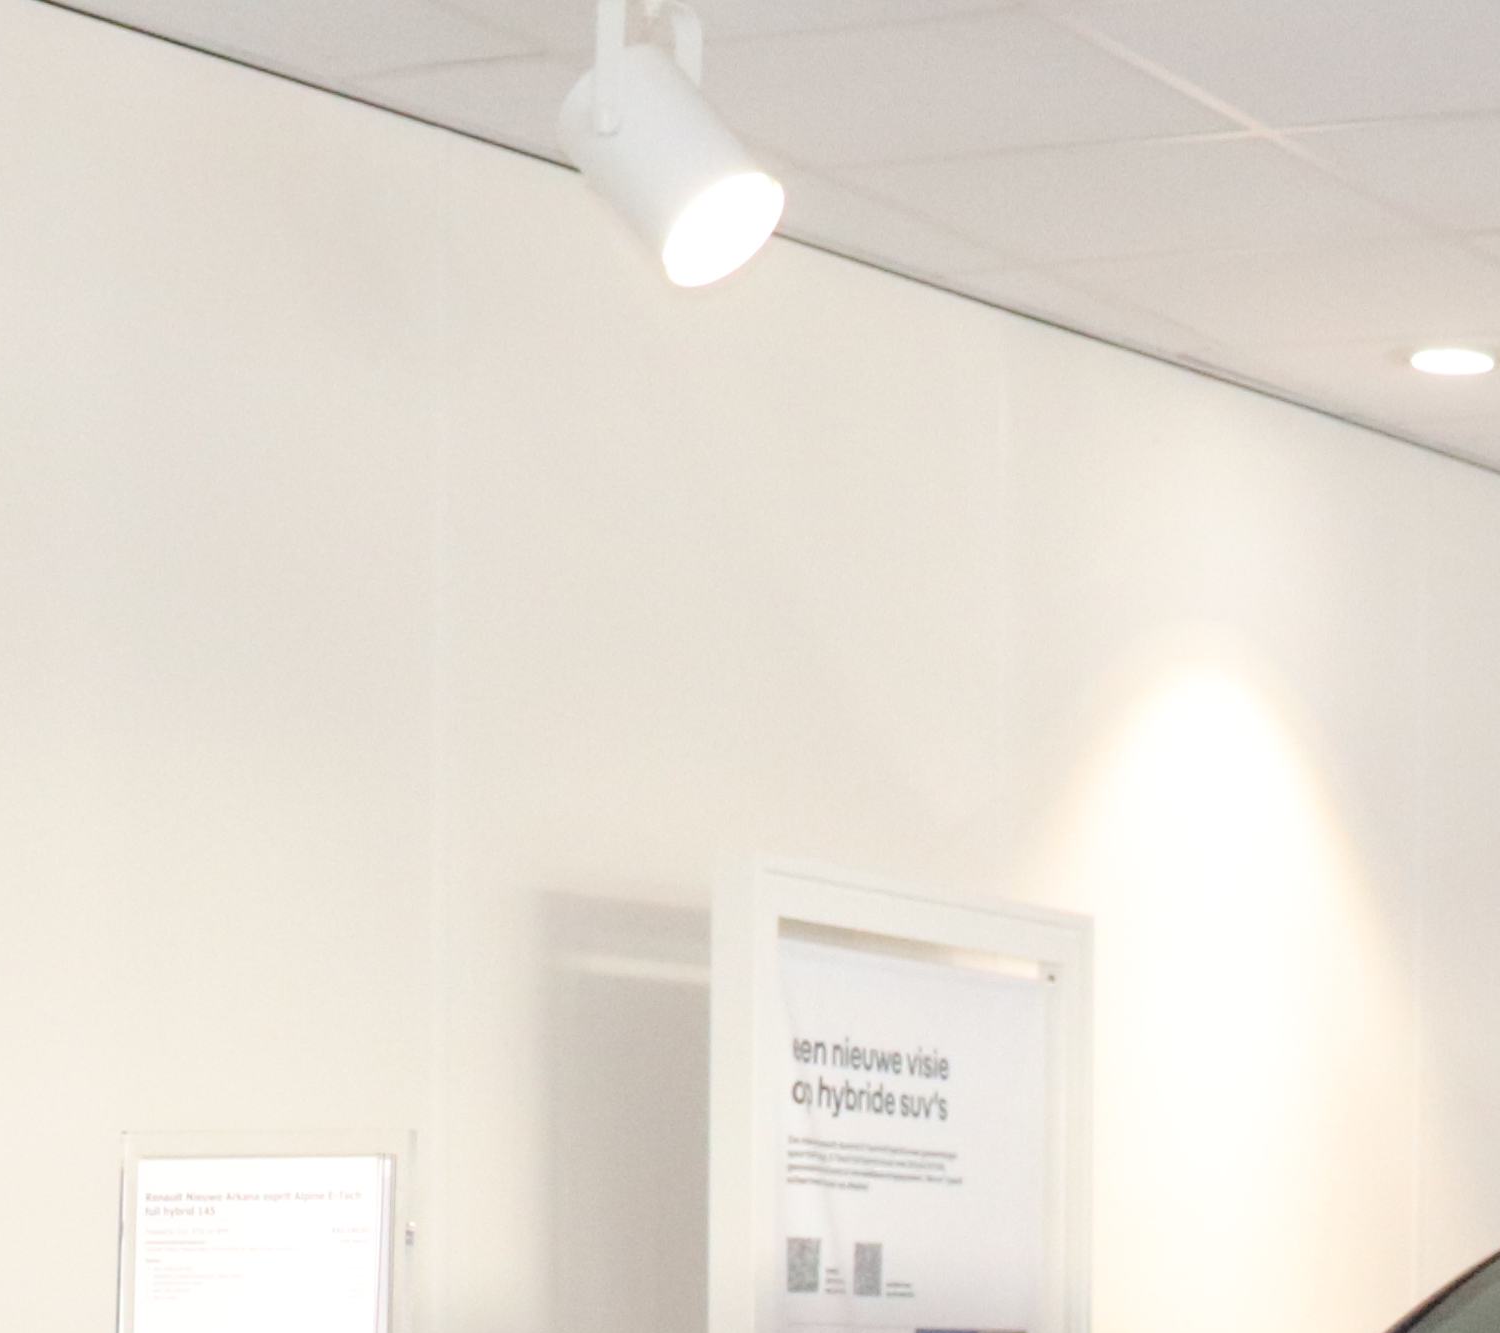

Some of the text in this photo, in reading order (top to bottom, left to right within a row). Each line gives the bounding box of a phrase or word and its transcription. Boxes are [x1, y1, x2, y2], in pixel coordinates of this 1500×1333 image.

[832, 1037, 902, 1075] nieuwe
[907, 1045, 950, 1081] visie
[817, 1074, 896, 1119] hybride
[900, 1089, 949, 1121] suv's
[145, 1192, 182, 1202] Renault
[186, 1192, 222, 1202] Nieuwe
[226, 1191, 260, 1201] Arkana
[294, 1191, 325, 1203] Alpine
[163, 1206, 195, 1219] hybrid
